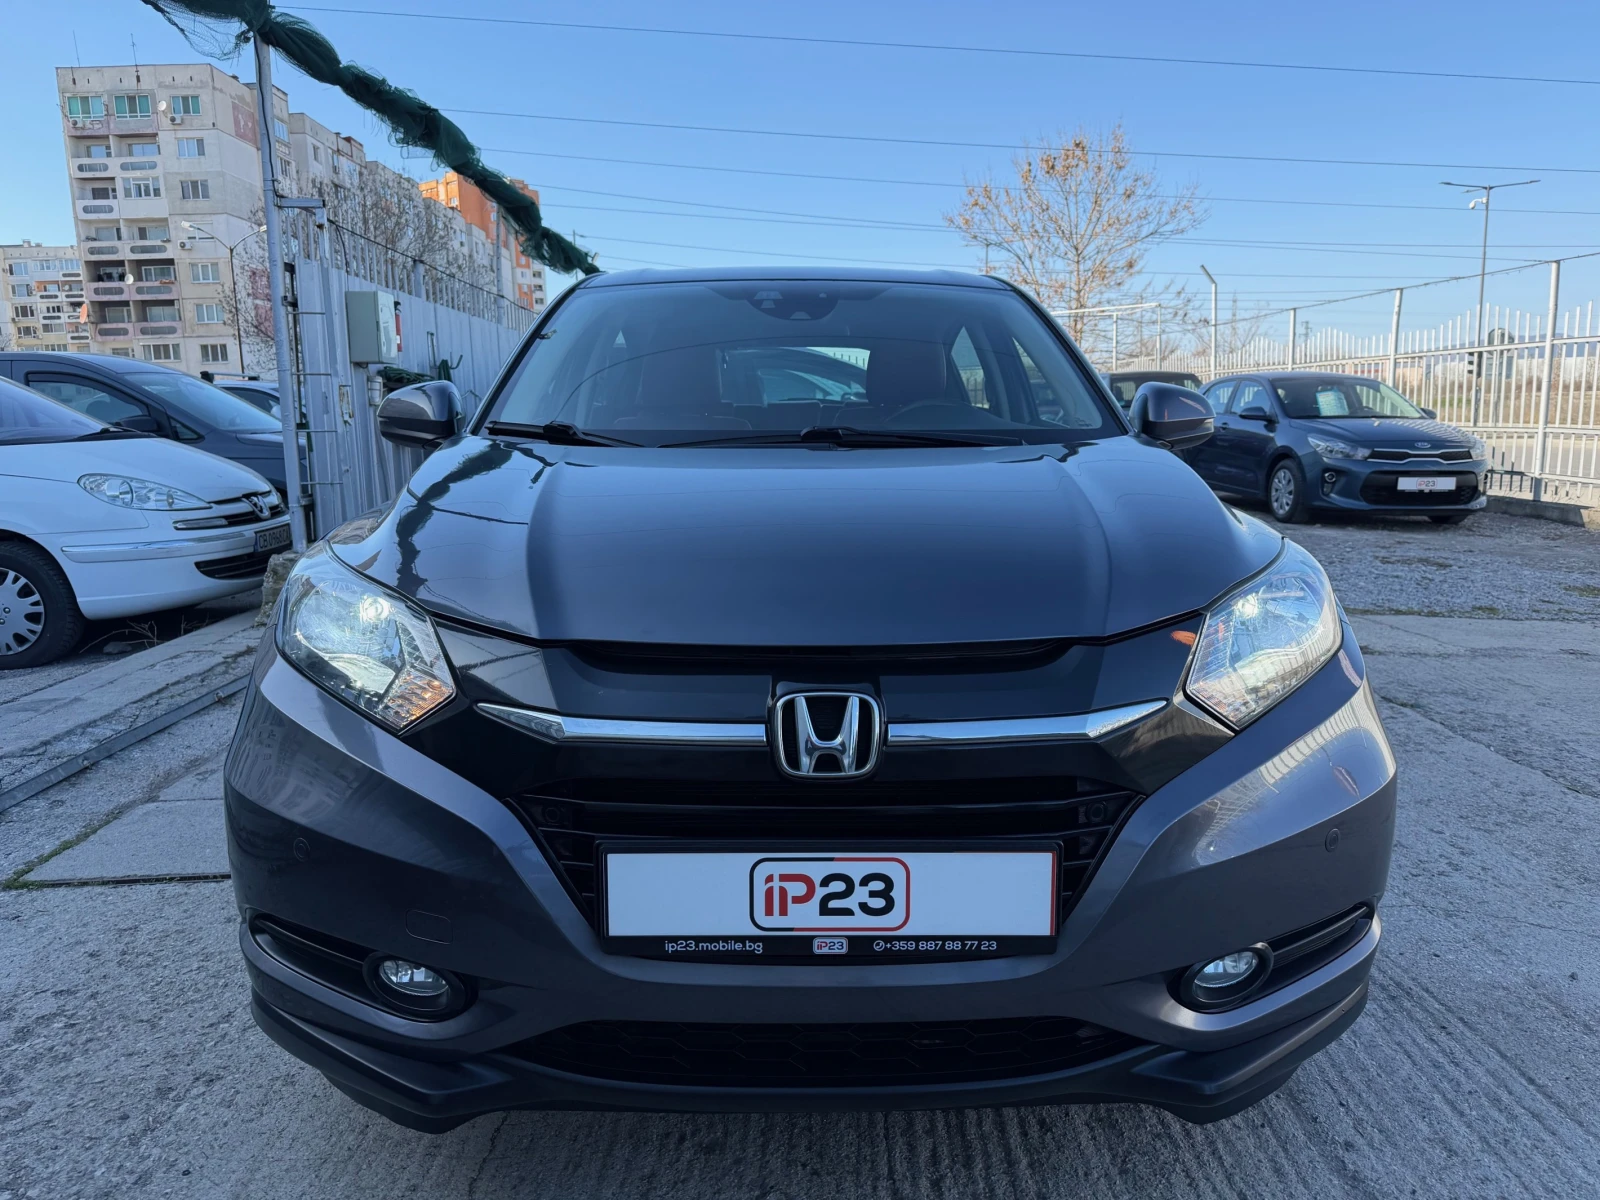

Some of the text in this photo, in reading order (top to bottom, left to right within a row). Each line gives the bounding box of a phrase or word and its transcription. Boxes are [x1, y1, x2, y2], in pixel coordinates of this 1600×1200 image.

[665, 940, 763, 954] ip23.mobile.bg
[886, 940, 997, 951] +359 887 88 77 23
